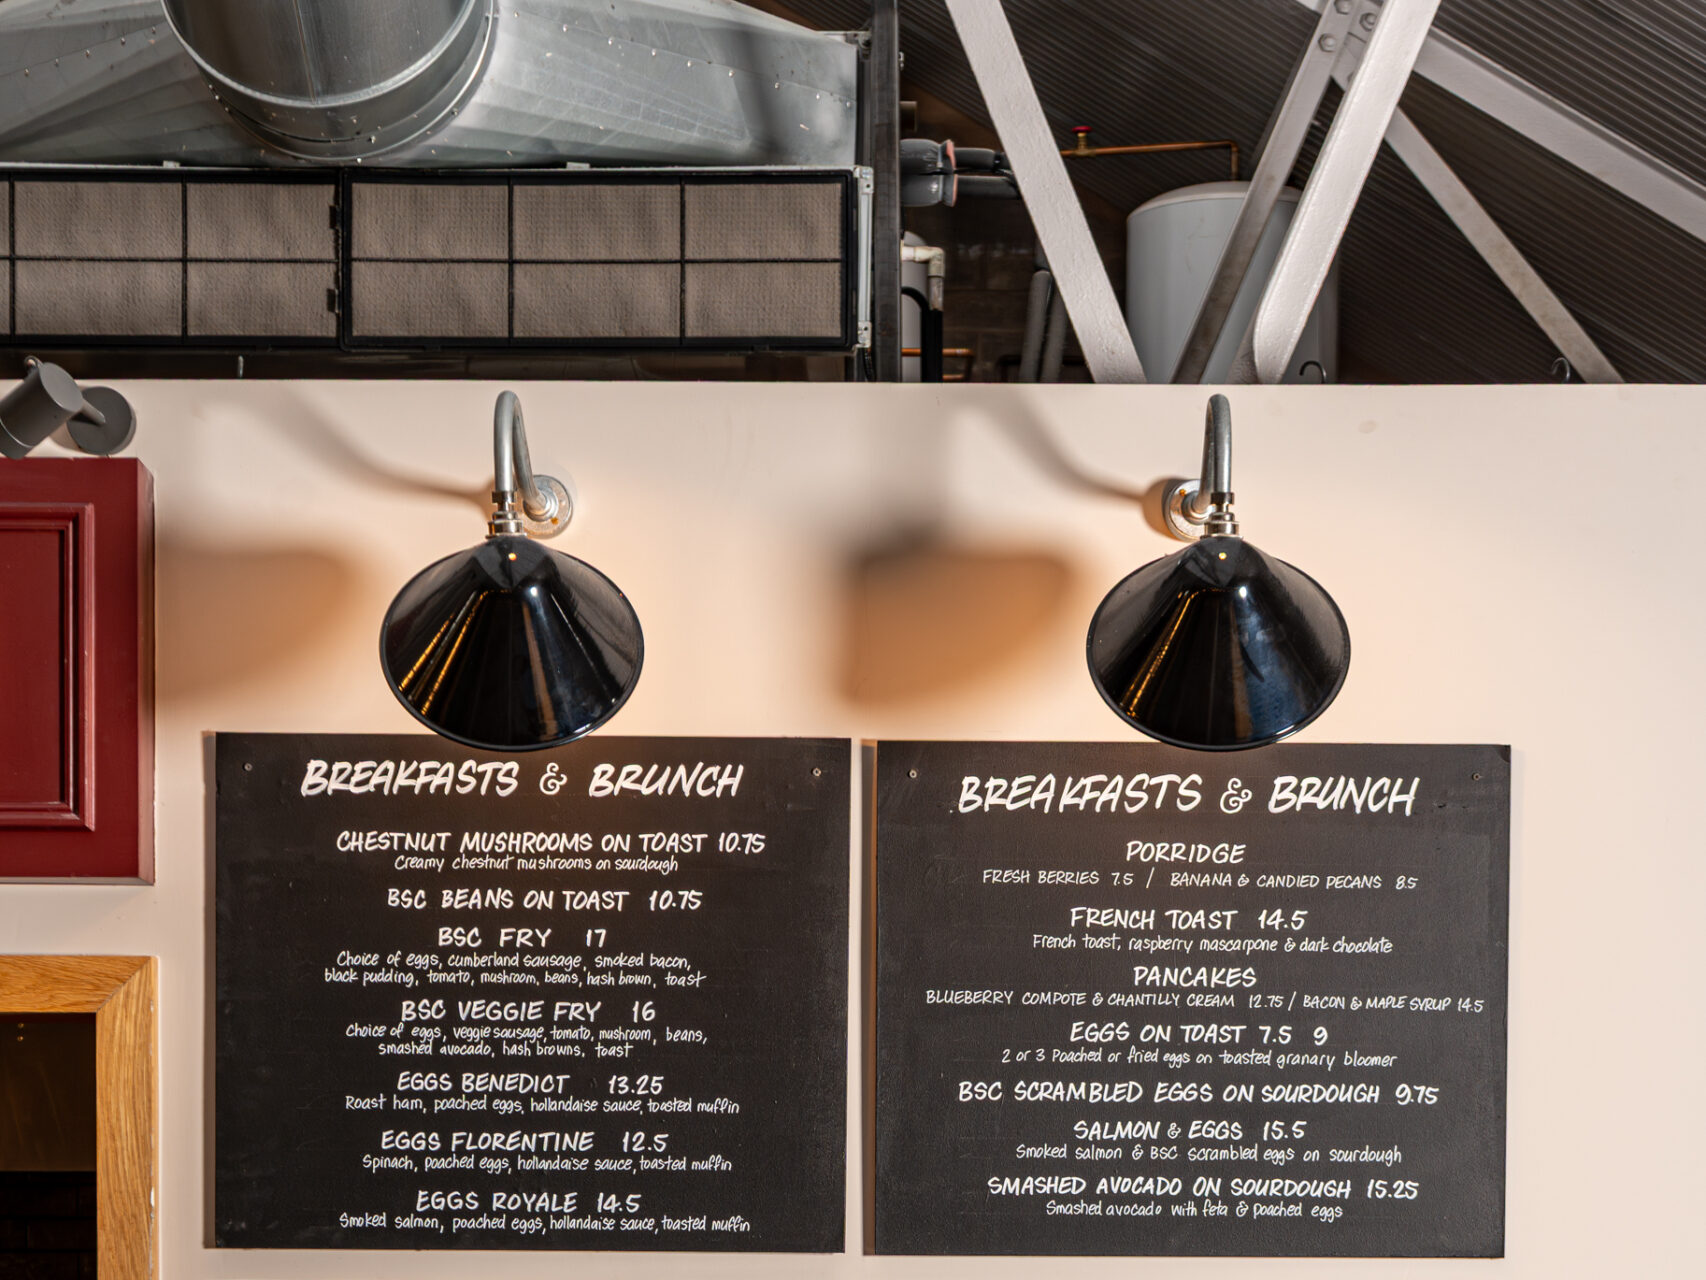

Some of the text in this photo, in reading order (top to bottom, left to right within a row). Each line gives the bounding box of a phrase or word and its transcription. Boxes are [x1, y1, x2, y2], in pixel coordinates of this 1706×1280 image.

[300, 758, 745, 799] BREAKFASTS & BRUNCH
[957, 772, 1421, 817] BREAKFASTS & BRUNCH
[335, 830, 767, 856] CHESTNUT MUSHROOMS ON TOAST 10.75
[1125, 840, 1247, 864] PORRIDGE
[394, 854, 679, 876] Creamy chestnut mushrooms on sourdough
[1069, 906, 1309, 931] FRENCH TOAST 14.5
[437, 926, 607, 949] BSC FRY 17
[1032, 933, 1077, 950] French
[1128, 934, 1194, 955] raspberry
[1199, 938, 1279, 956] mascarpone
[1283, 936, 1297, 953] &
[1298, 936, 1330, 953] dark
[1332, 935, 1394, 954] chocolate
[1133, 965, 1257, 989] PANCAKES
[400, 998, 656, 1024] BSC VEGGIE FRY 16
[396, 1070, 665, 1096] EGGS BENEDICT 13.25
[958, 1079, 1440, 1106] BSC SCRAMBLED EGGS ON SOURDOUGH 9.75
[345, 1092, 388, 1111] Roast
[433, 1093, 488, 1114] poached
[530, 1094, 599, 1113] hollandaise
[646, 1096, 693, 1113] toasted
[696, 1097, 740, 1115] muffin
[380, 1129, 670, 1153] EGGS FLORENTINE 12.5
[1073, 1119, 1308, 1142] SALMON & EGGS 15.5
[1045, 1198, 1344, 1224] Smashed avocado with feta & poached eggs
